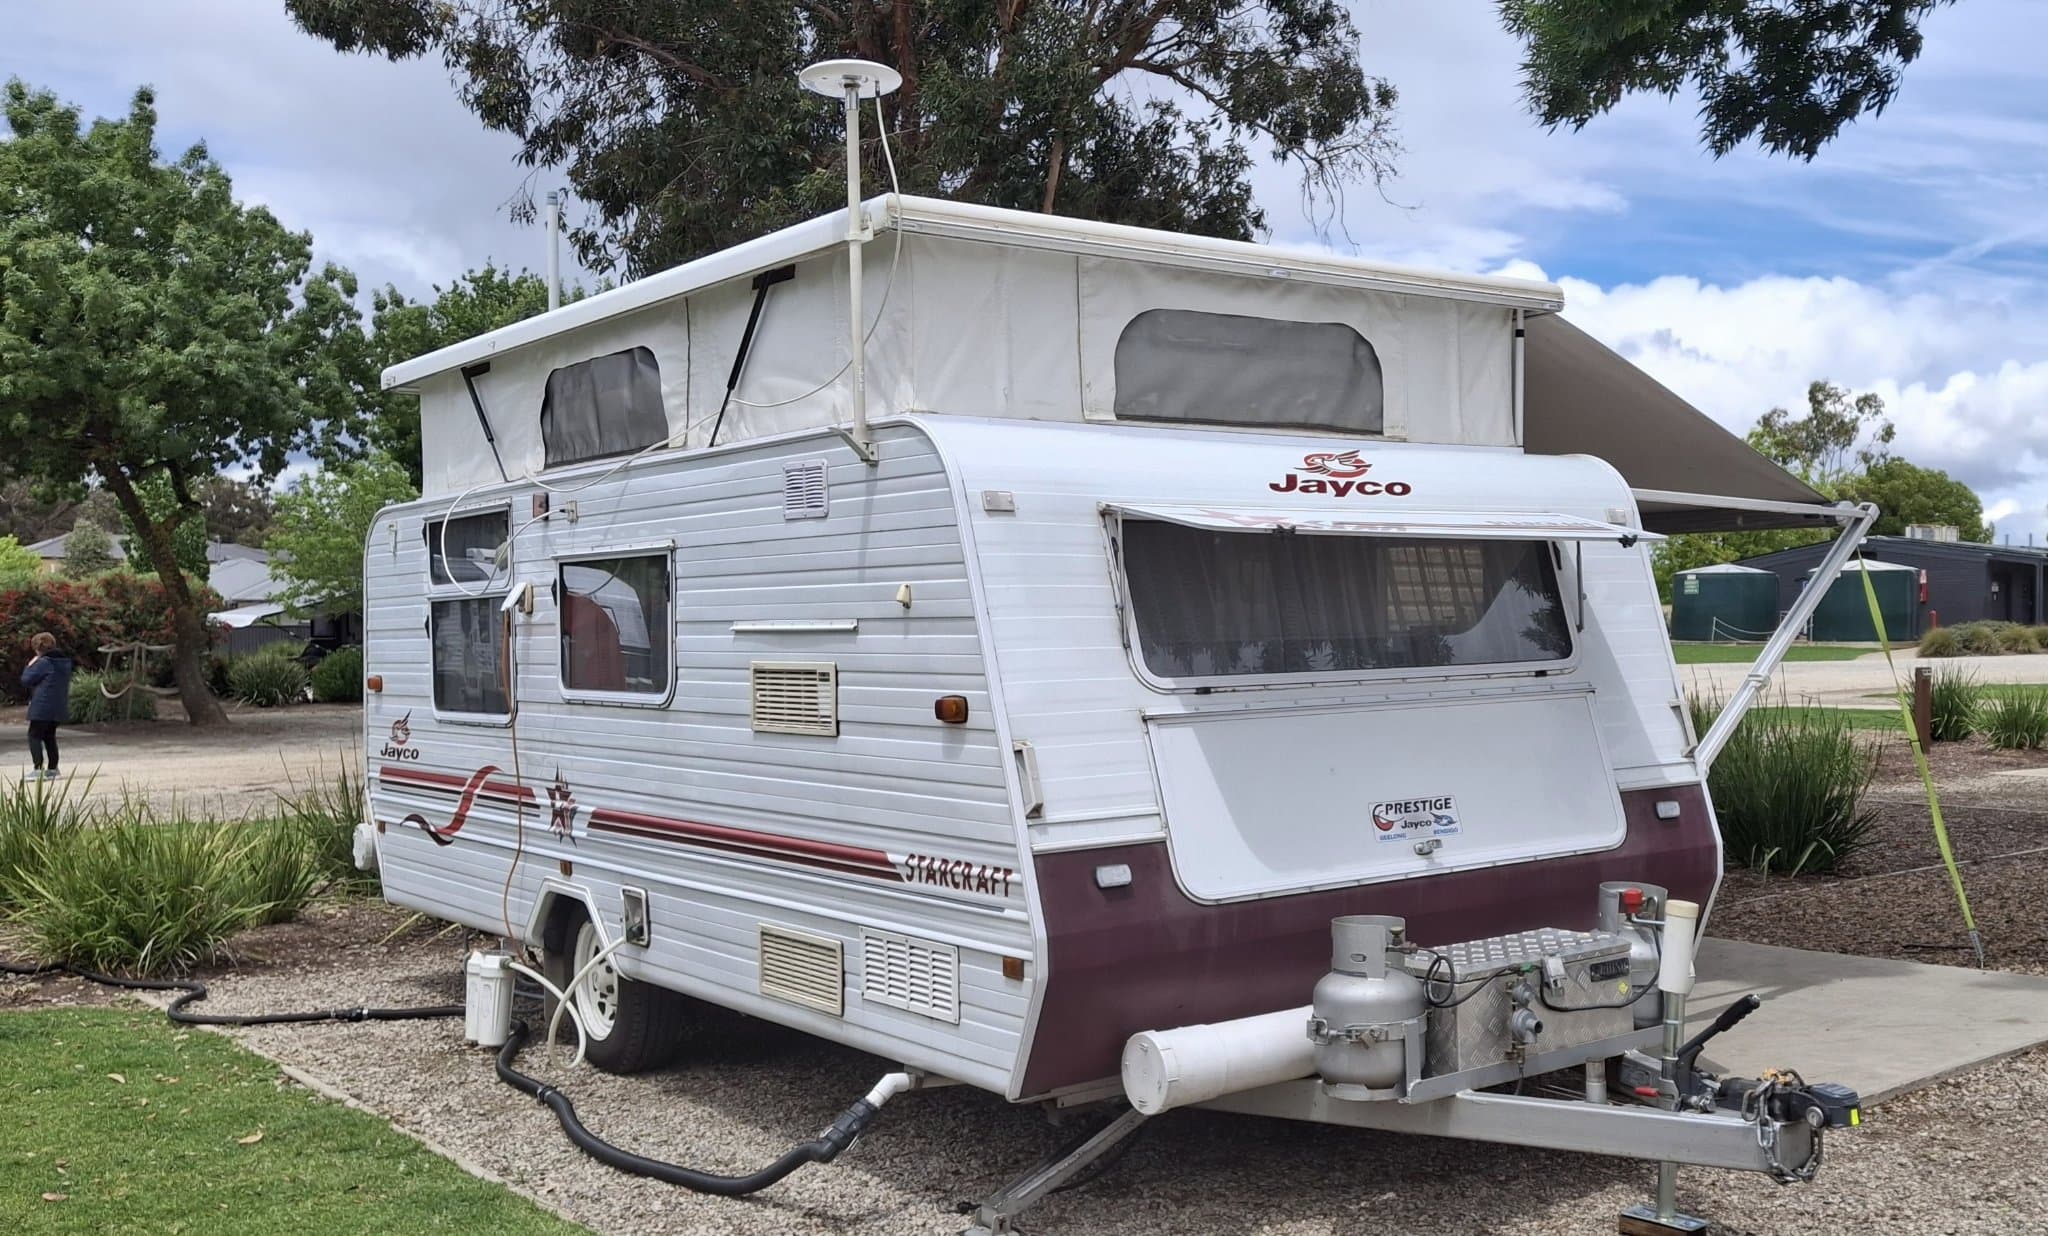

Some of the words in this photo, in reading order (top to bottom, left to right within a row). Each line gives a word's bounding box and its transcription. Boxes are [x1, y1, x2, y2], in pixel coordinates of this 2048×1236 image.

[1269, 474, 1412, 498] Jayco
[380, 742, 420, 761] Jayco
[1385, 797, 1452, 815] PRESTIGE
[1401, 819, 1433, 830] Jayco
[905, 853, 1013, 898] STARCRAFT
